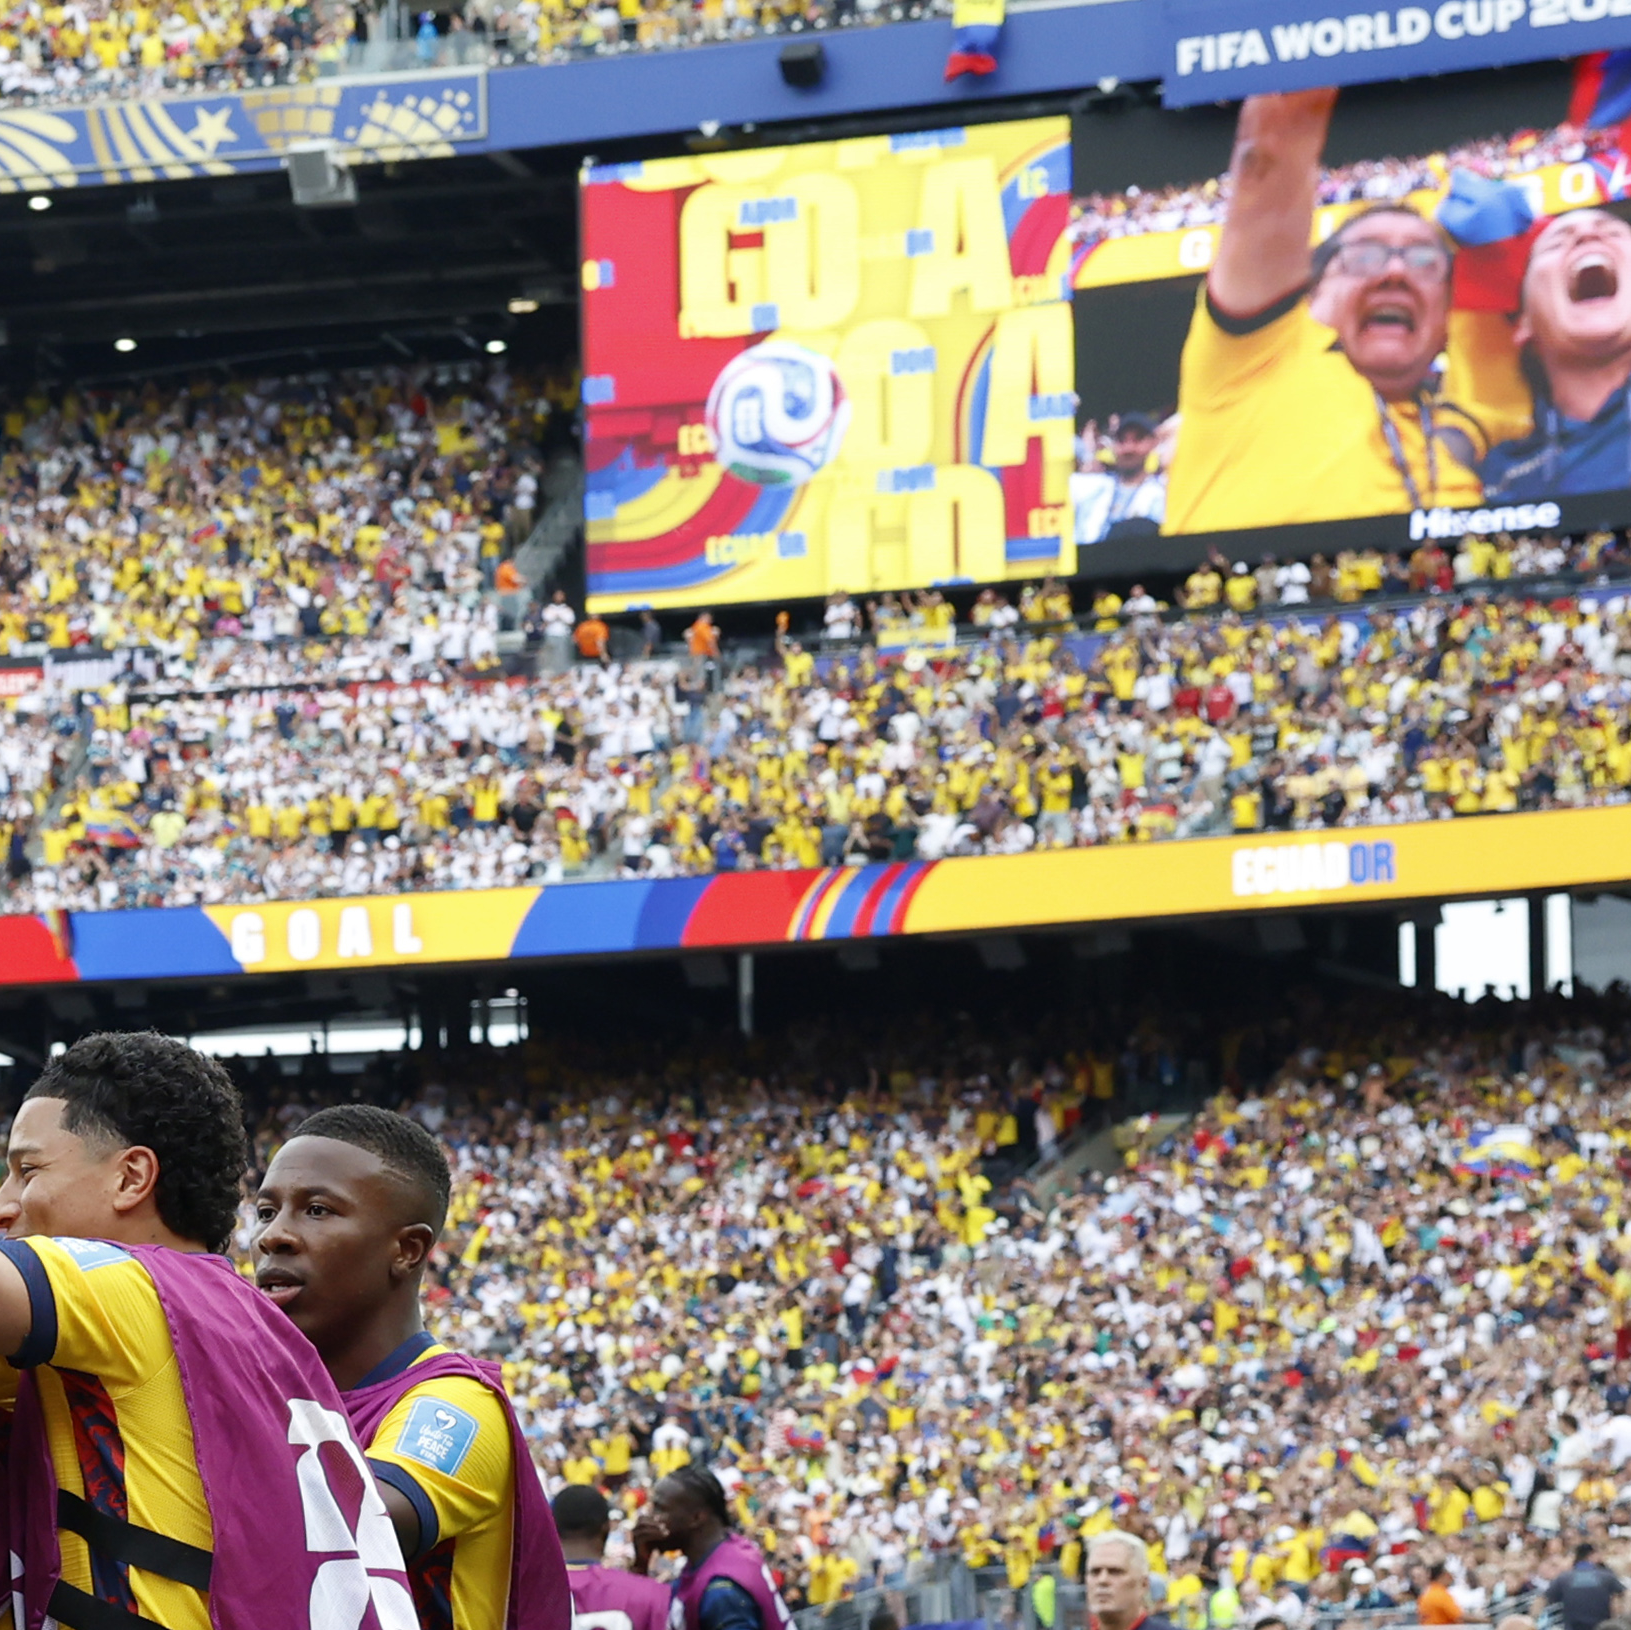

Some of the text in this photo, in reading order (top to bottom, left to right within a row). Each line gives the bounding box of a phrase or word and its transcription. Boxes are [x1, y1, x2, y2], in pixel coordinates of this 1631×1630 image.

[1175, 29, 1270, 76] FIFA
[1270, 8, 1431, 62] WORLD
[1433, 0, 1526, 40] CUP
[1409, 501, 1561, 541] Hisense
[1232, 840, 1395, 896] ECUADOR
[231, 903, 423, 964] GOAL
